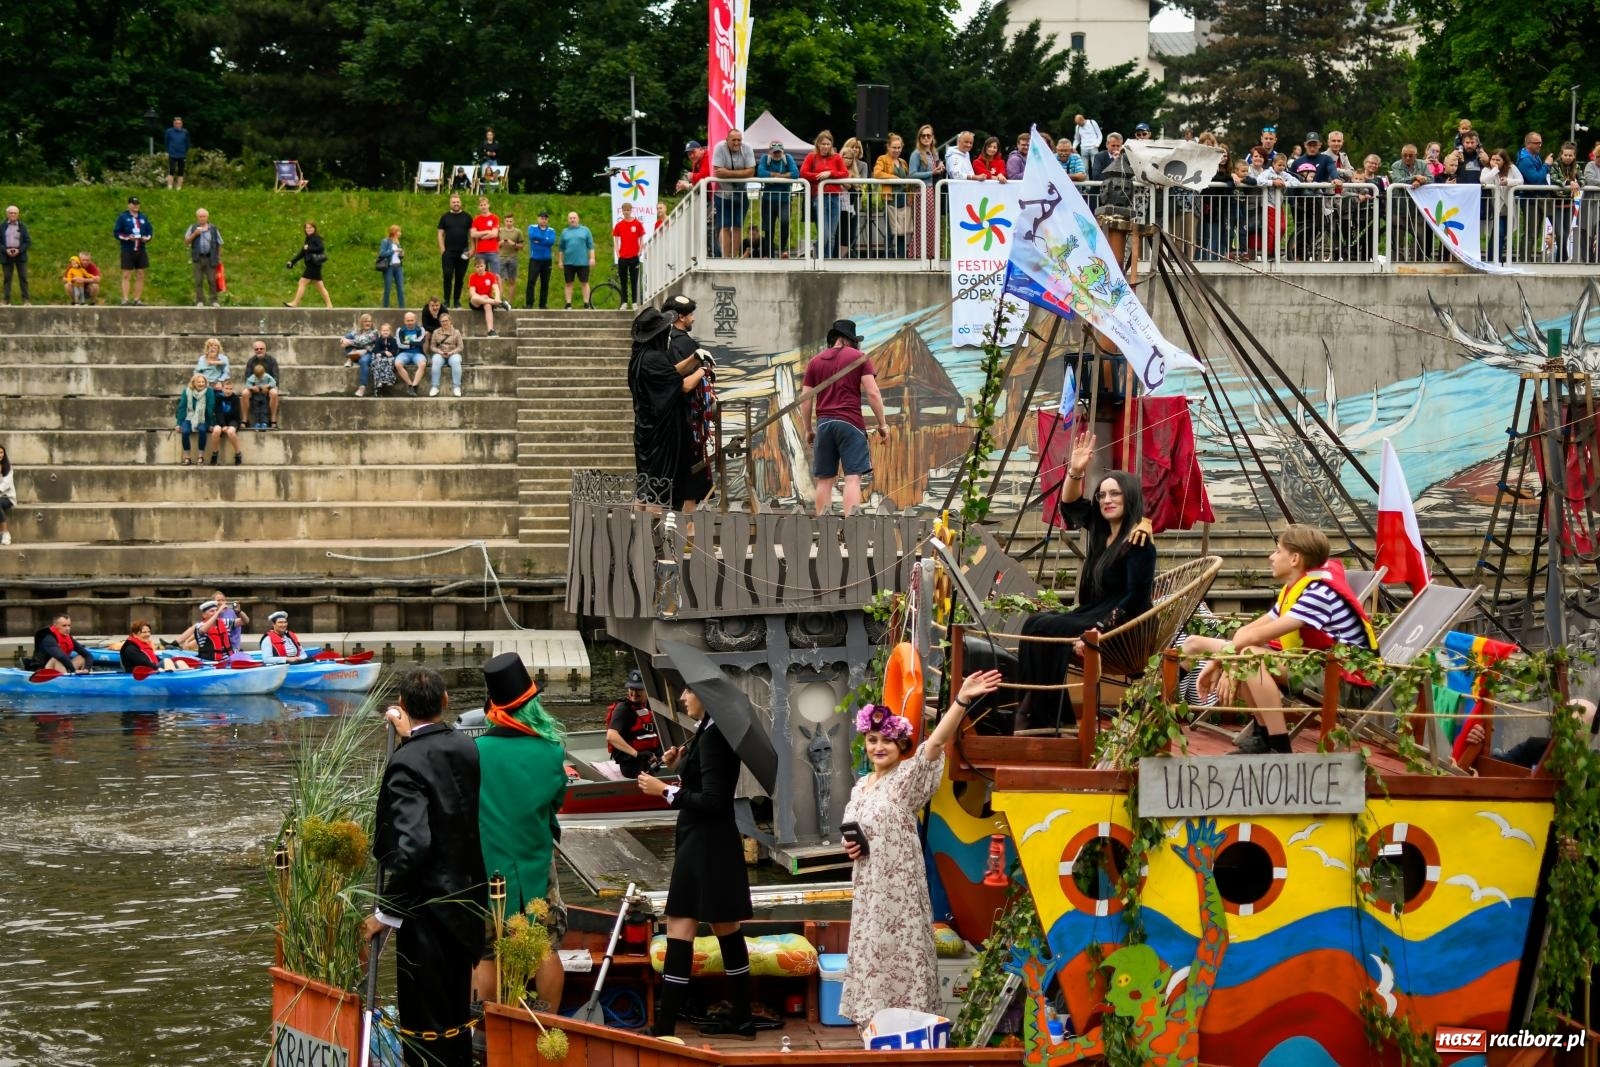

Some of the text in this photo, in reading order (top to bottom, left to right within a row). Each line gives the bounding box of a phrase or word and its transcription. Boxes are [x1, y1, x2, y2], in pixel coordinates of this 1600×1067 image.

[617, 207, 654, 216] FTIWAL
[957, 260, 1007, 272] FESTIW
[1164, 762, 1342, 811] URBANOWICE
